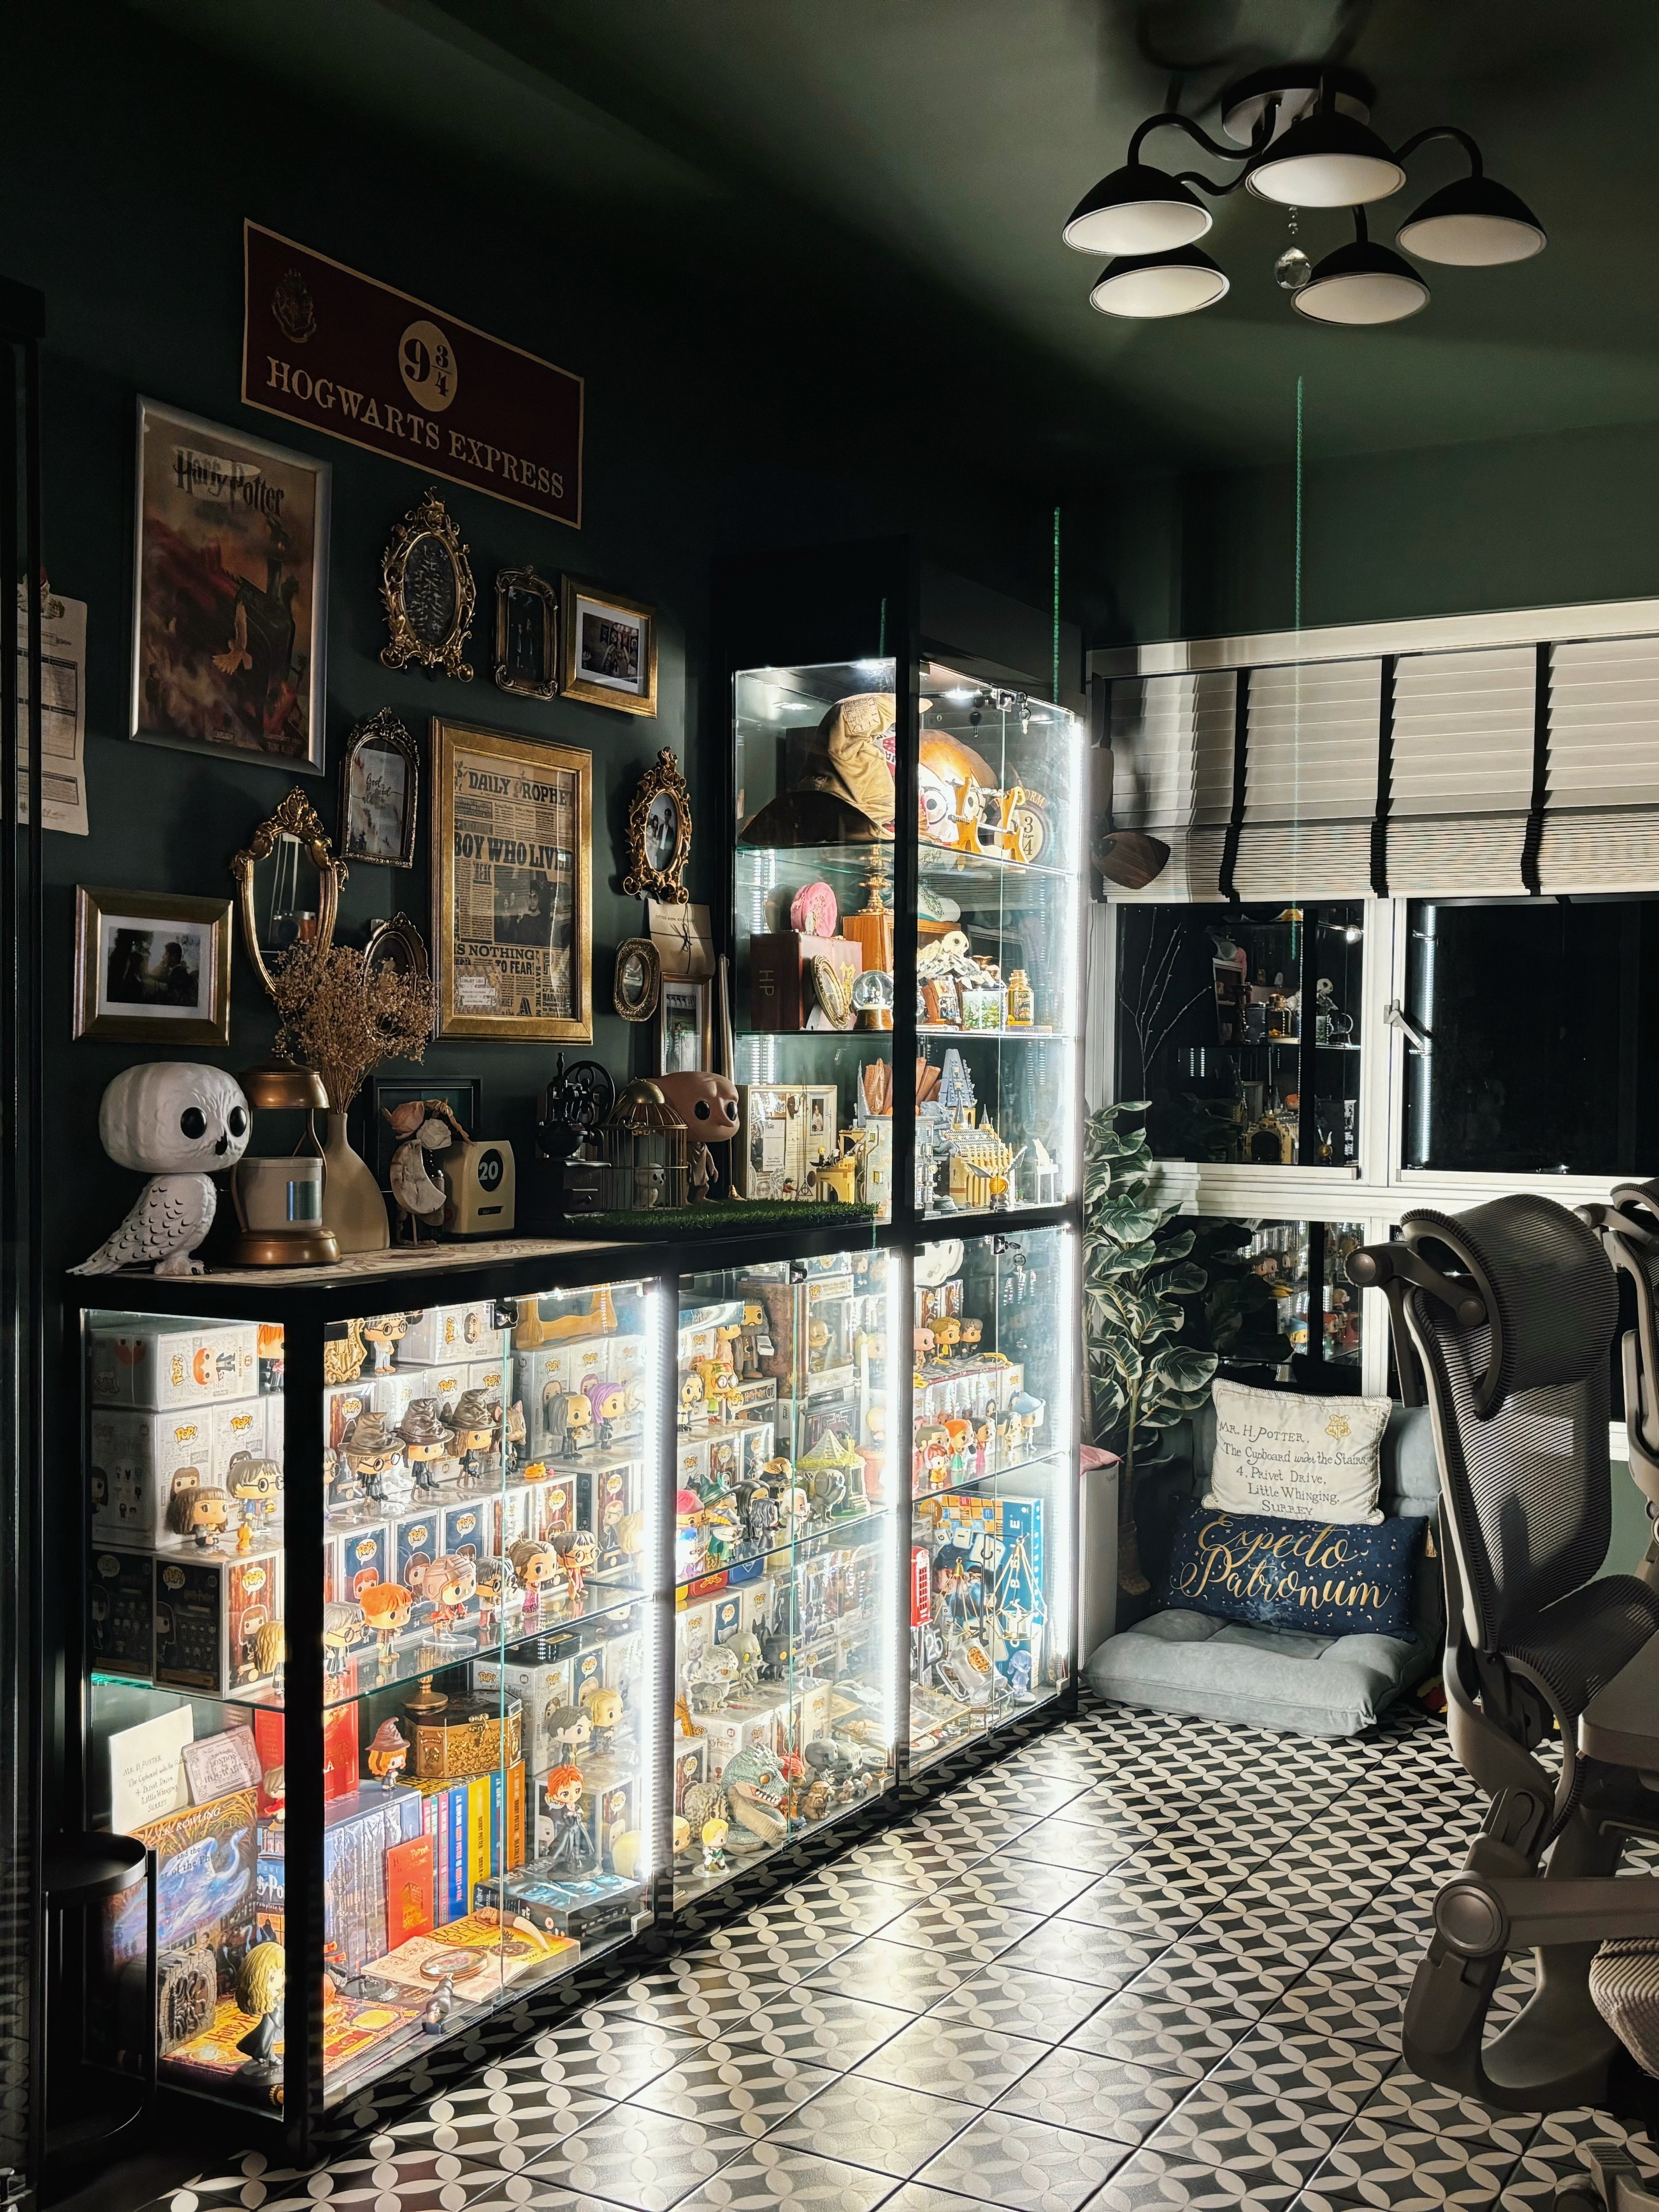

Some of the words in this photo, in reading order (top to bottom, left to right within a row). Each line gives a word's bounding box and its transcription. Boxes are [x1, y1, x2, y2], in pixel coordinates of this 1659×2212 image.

[267, 356, 439, 450] HOGWARTS
[449, 430, 564, 499] EXPRESS
[173, 449, 228, 497] Harry
[230, 462, 284, 518] Potter
[469, 771, 511, 795] DAILY
[487, 837, 527, 866] WHO
[469, 944, 534, 960] NOTHING
[759, 970, 774, 996] HP
[479, 1161, 498, 1180] 20
[483, 1374, 500, 1388] POP!
[230, 1416, 252, 1432] POP!
[174, 1426, 197, 1443] POP!
[1223, 1442, 1241, 1457] The
[1245, 1446, 1290, 1465] Cupboard
[1294, 1452, 1317, 1463] under
[1317, 1452, 1332, 1464] the
[1247, 1482, 1279, 1497] Little
[456, 1515, 476, 1532] POP!
[408, 1527, 427, 1544] POP!
[1197, 1514, 1358, 1569] Expecto
[356, 1541, 377, 1558] POP!
[243, 1570, 264, 1591] POP!
[1170, 1543, 1393, 1610] Patronum
[925, 1628, 944, 1664] 25
[478, 1671, 496, 1684] POP!
[210, 1753, 238, 1767] LONDON
[204, 1761, 248, 1783] HOGWARTS
[176, 1807, 221, 1831] ROWLING
[177, 1851, 188, 1860] and
[190, 1847, 201, 1855] the
[171, 1866, 181, 1876] of
[182, 1858, 197, 1871] the
[203, 2022, 248, 2043] Harry
